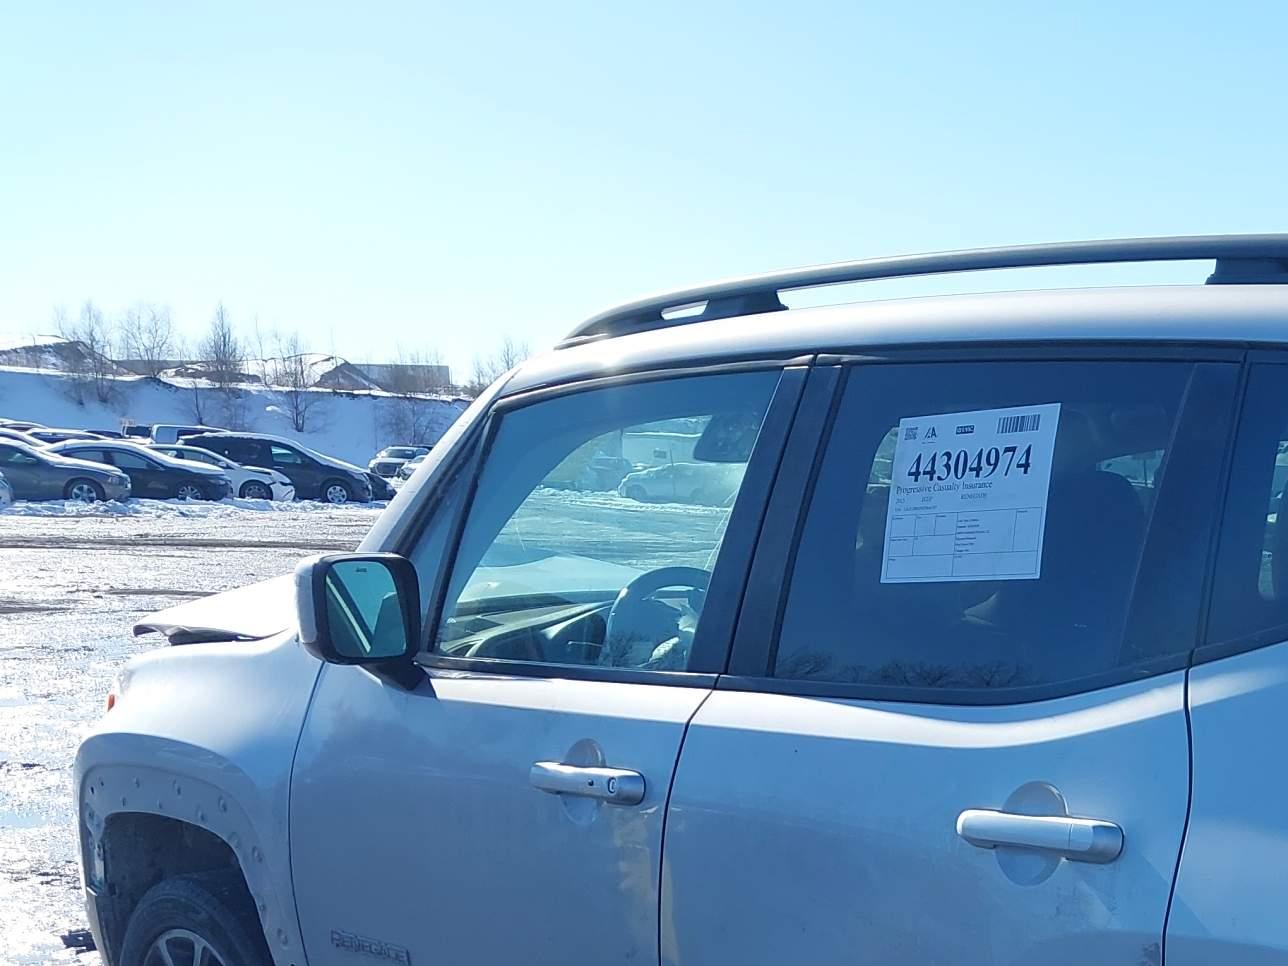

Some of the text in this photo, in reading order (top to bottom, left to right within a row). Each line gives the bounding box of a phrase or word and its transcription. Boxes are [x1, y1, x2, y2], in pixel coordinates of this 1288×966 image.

[907, 444, 1032, 482] 44304974
[896, 481, 992, 495] Progressive Casualty Insurance
